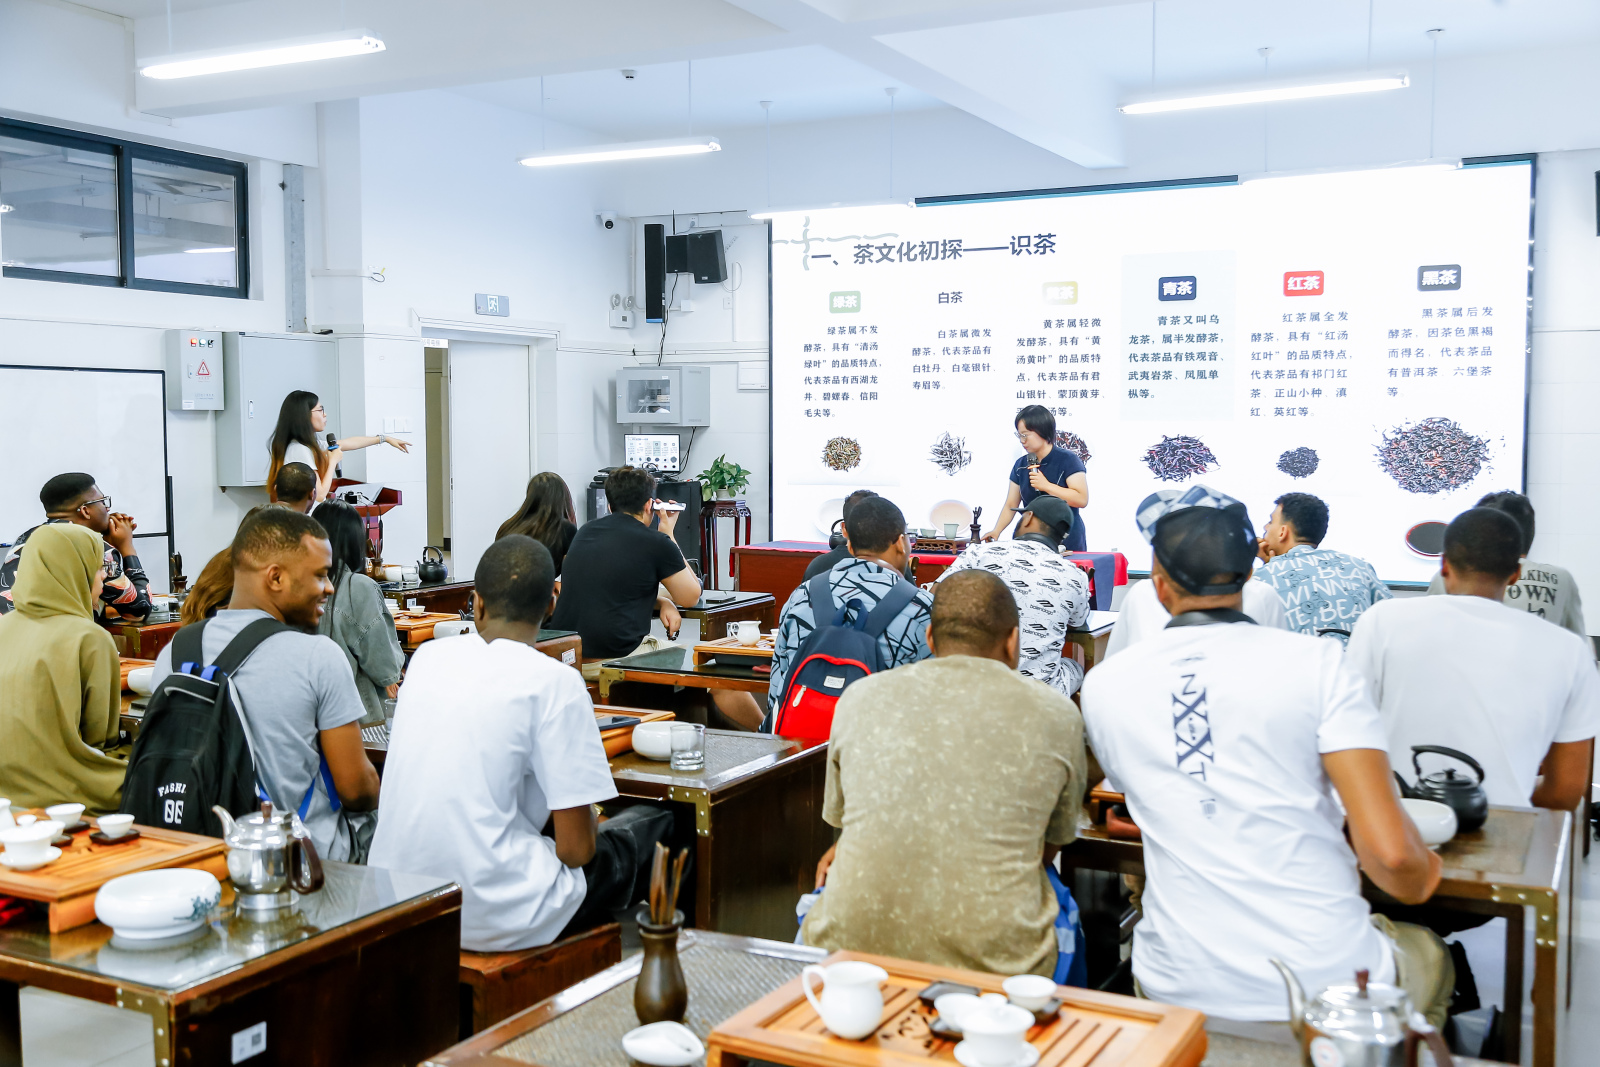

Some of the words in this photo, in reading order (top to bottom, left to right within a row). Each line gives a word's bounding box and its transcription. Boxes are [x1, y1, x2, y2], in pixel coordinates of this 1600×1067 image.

[811, 233, 1057, 266] 一、茶文化初探——识茶
[1287, 275, 1321, 291] 红茶
[1421, 269, 1458, 286] 黑茶
[1045, 285, 1076, 301] 茶
[1162, 280, 1194, 296] 青茶
[832, 295, 858, 308] 绿茶
[937, 290, 964, 305] 白茶
[1281, 310, 1349, 323] 红茶属全发
[1421, 306, 1494, 319] 黑茶属后发
[1042, 317, 1102, 330] 黄茶属轻微
[1156, 313, 1220, 327] 青茶又叫乌
[826, 324, 879, 336] 绿茶属不发
[937, 328, 992, 339] 白茶属微发
[803, 374, 879, 386] 代表茶品有西湖龙
[1015, 370, 1101, 383] 点，代表茶品有君
[1250, 368, 1348, 380] 代表茶品有祁门红
[803, 391, 879, 402] 井、碧螺春、信阳
[1127, 388, 1155, 400] 枞等。
[803, 407, 836, 418] 毛尖等。
[1518, 569, 1558, 585] LKING
[1319, 599, 1364, 622] BEA
[158, 781, 187, 798] FASHI
